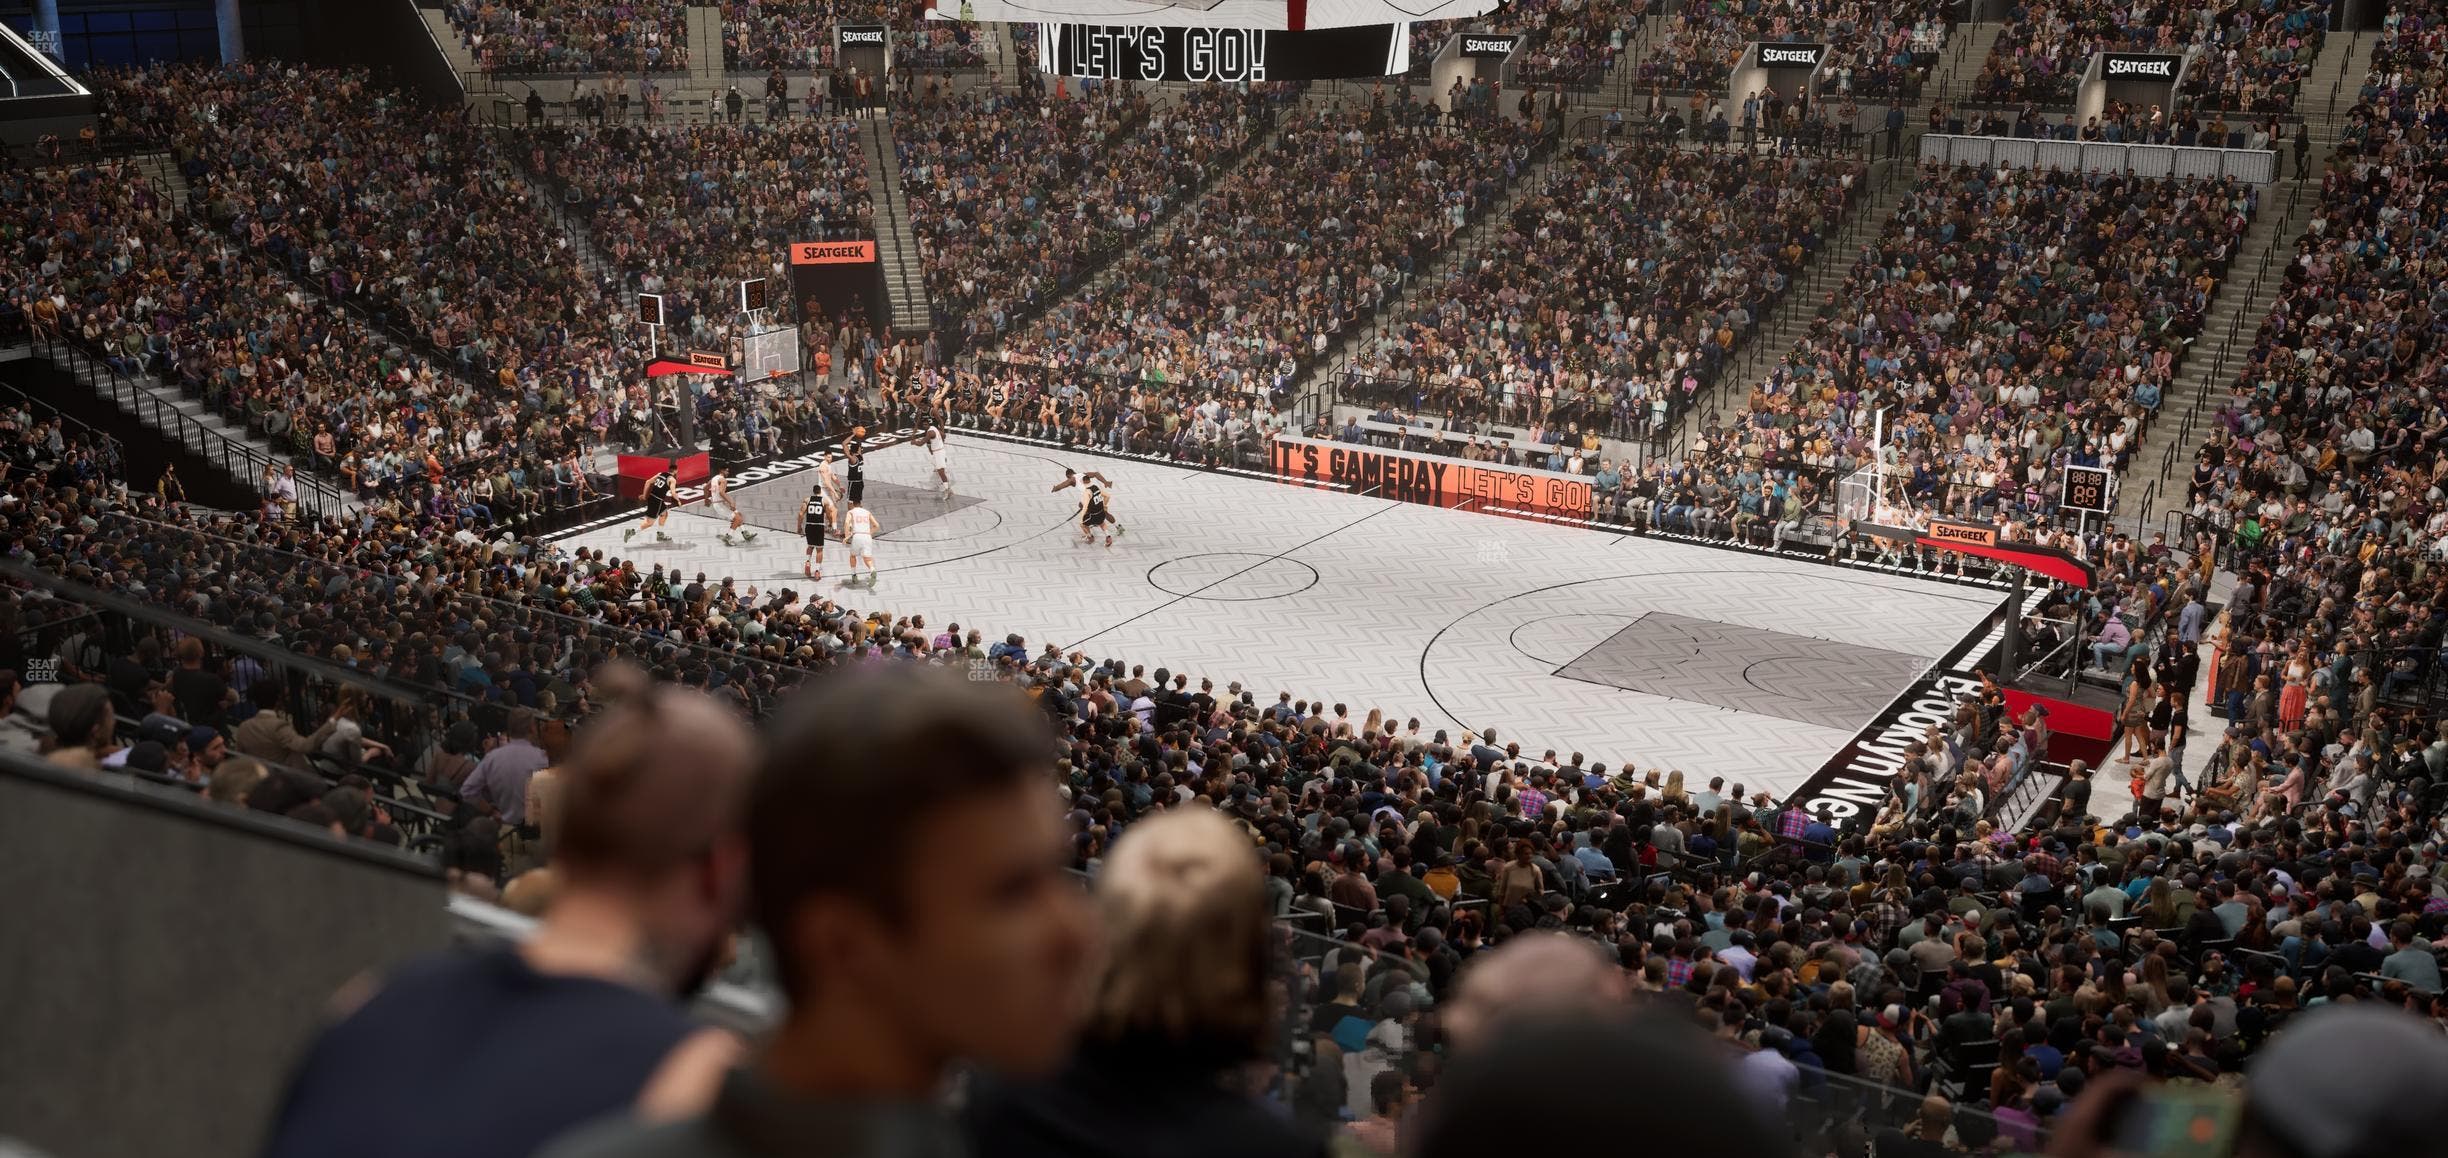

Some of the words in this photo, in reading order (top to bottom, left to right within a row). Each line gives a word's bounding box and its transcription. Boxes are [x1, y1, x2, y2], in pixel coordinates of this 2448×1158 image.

[842, 31, 883, 43] SEATGEEK
[1071, 24, 1165, 81] LET'S
[1183, 26, 1265, 82] GO!
[1466, 39, 1512, 53] SEATGEEK
[1763, 48, 1817, 64] SEATGEEK
[2108, 59, 2172, 76] SEATGEEK
[803, 245, 865, 259] SEATGEEK
[693, 354, 722, 367] SEATGEEK
[1271, 440, 1319, 473] IT'S
[1330, 449, 1448, 490] GAMEDAY
[1458, 466, 1534, 504] LET'S
[1547, 478, 1592, 512] GO!
[808, 505, 823, 515] 00
[1936, 526, 1988, 543] SEATGEEK
